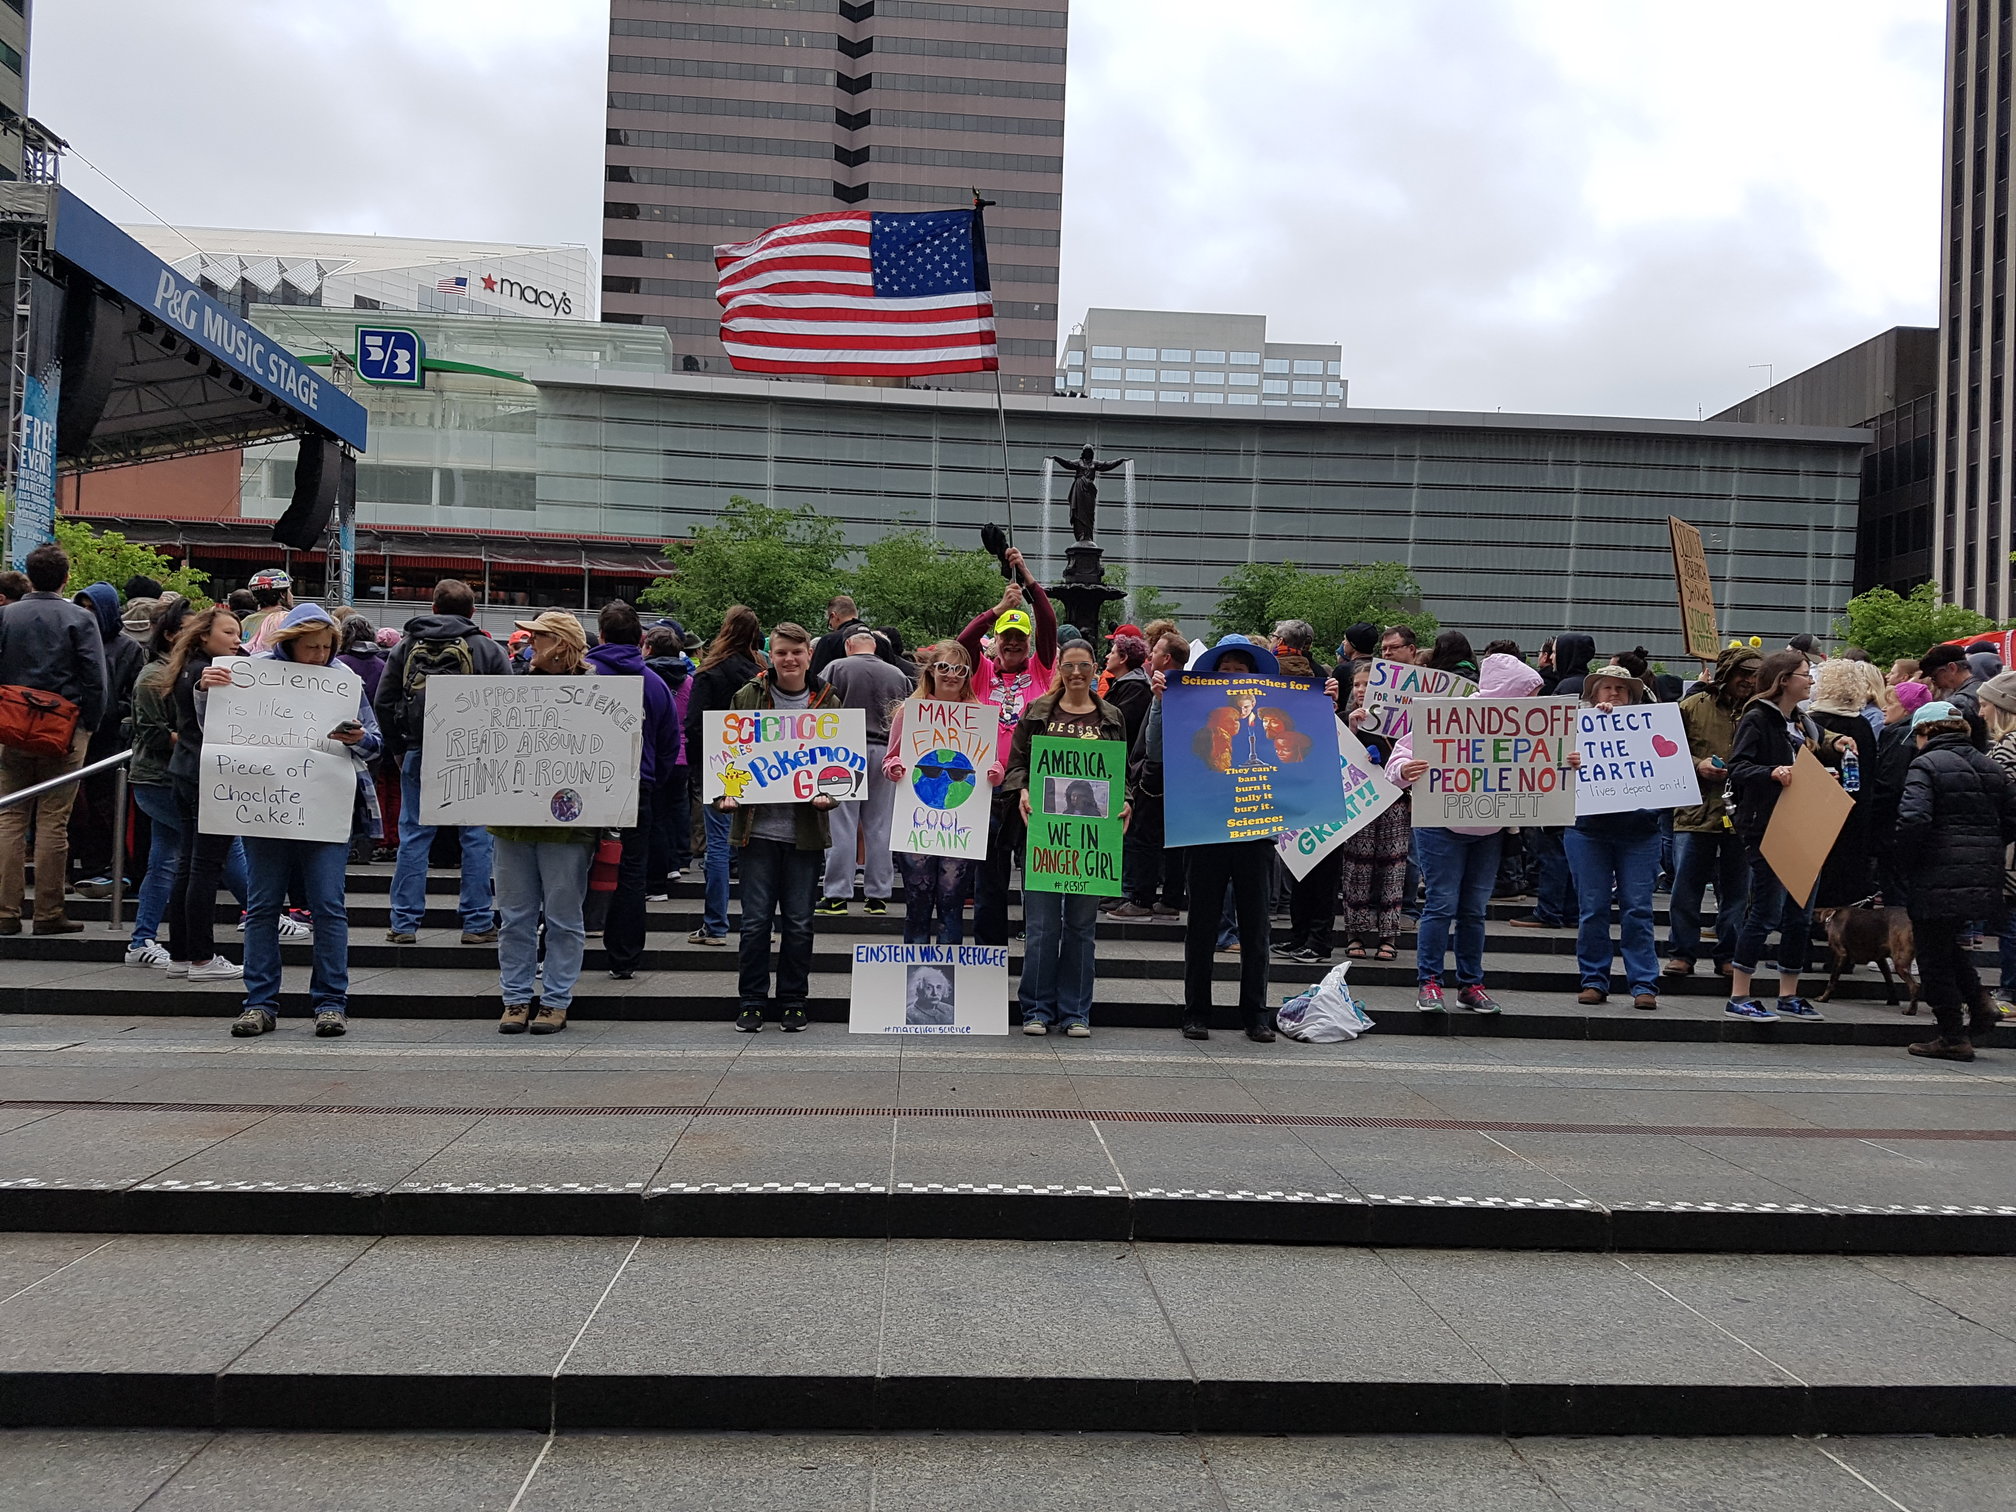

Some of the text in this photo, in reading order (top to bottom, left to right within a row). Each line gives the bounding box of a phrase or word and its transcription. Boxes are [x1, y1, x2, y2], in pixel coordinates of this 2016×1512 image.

[500, 277, 572, 316] macy's
[153, 268, 319, 411] P&G MUSIC STAGE
[21, 413, 53, 457] FREE
[1685, 579, 1711, 605] SHOWS
[230, 661, 349, 698] Science
[1181, 676, 1312, 691] Science searches for
[1369, 662, 1450, 694] STAND
[1226, 687, 1266, 697] truth.
[1374, 691, 1388, 702] FOR
[227, 698, 317, 722] is like a
[424, 703, 446, 734] I
[918, 703, 981, 730] MAKE
[1361, 704, 1413, 738] STA
[1427, 705, 1576, 736] HANDS OFF
[722, 712, 840, 745] Science
[446, 727, 604, 758] READ AROUND
[912, 728, 990, 766] EARTH
[1433, 738, 1485, 764] THE
[1584, 740, 1629, 759] THE
[216, 755, 315, 778] Piece of
[709, 745, 753, 770] MAKES
[748, 743, 867, 788] Pokémon
[1037, 748, 1113, 780] AMERICA,
[1225, 765, 1278, 775] They can't
[1429, 767, 1572, 793] PEOPLE NOT
[1579, 760, 1655, 783] EARTH
[213, 784, 301, 804] Choclate
[1235, 785, 1261, 793] burn
[1235, 794, 1262, 803] bully
[1590, 784, 1616, 798] lives
[1622, 780, 1652, 797] depend
[1660, 781, 1671, 791] on
[1234, 803, 1274, 813] bury it.
[1443, 793, 1544, 819] PROFIT
[913, 806, 973, 835] COOL
[1227, 815, 1284, 828] Science:
[1229, 828, 1270, 839] Bring
[907, 829, 972, 852] AGAIN
[1047, 821, 1099, 850] WE IN
[1032, 846, 1119, 882] DANGER, GIRL
[856, 945, 1007, 968] EINSTEIN WAS A REFUGEE
